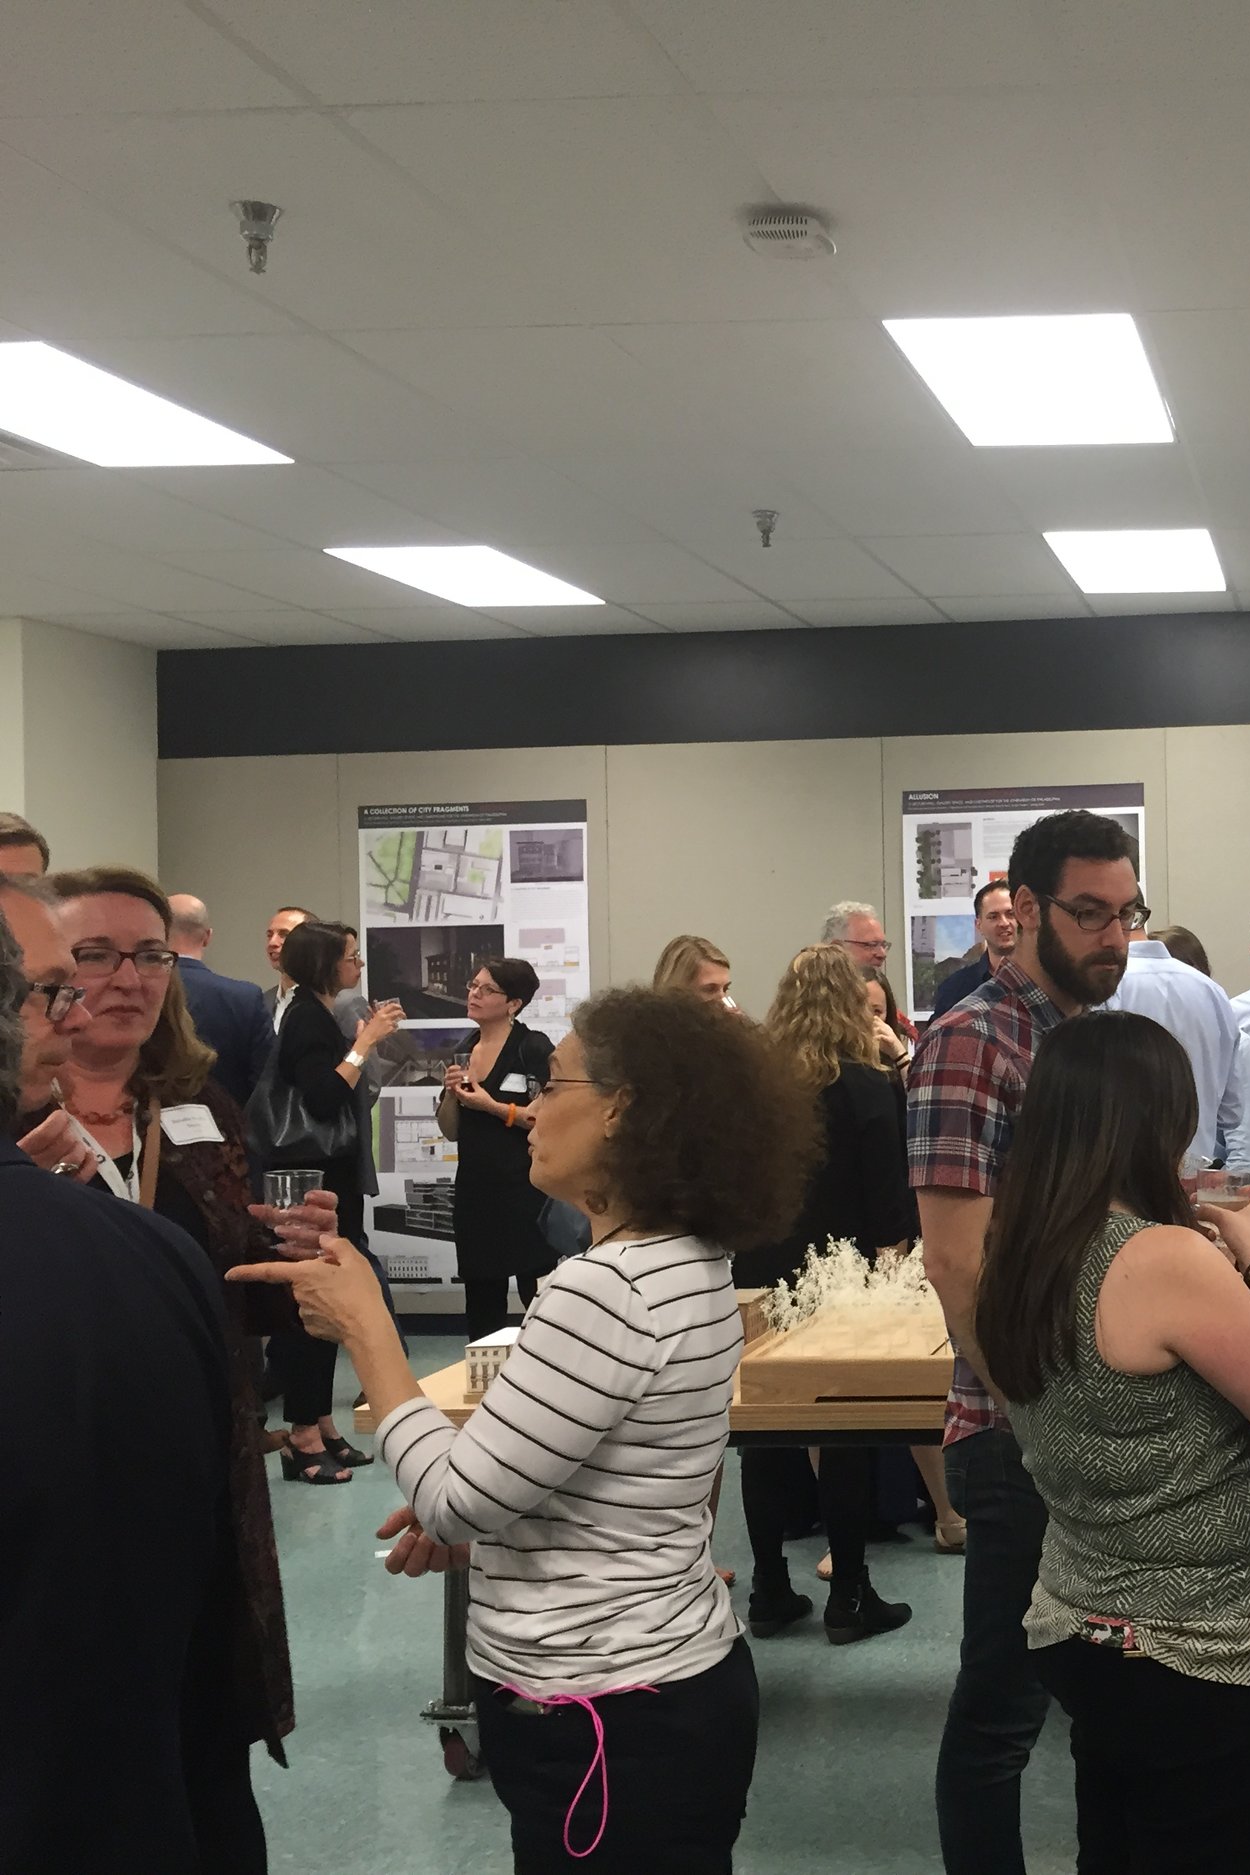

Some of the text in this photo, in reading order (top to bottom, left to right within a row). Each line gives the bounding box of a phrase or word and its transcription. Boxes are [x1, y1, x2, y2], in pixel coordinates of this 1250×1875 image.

[908, 793, 939, 801] ALLUSION
[369, 807, 407, 815] COLLECTION
[408, 806, 417, 814] OF
[418, 806, 432, 814] CITY
[433, 805, 470, 813] FRAGMENTS
